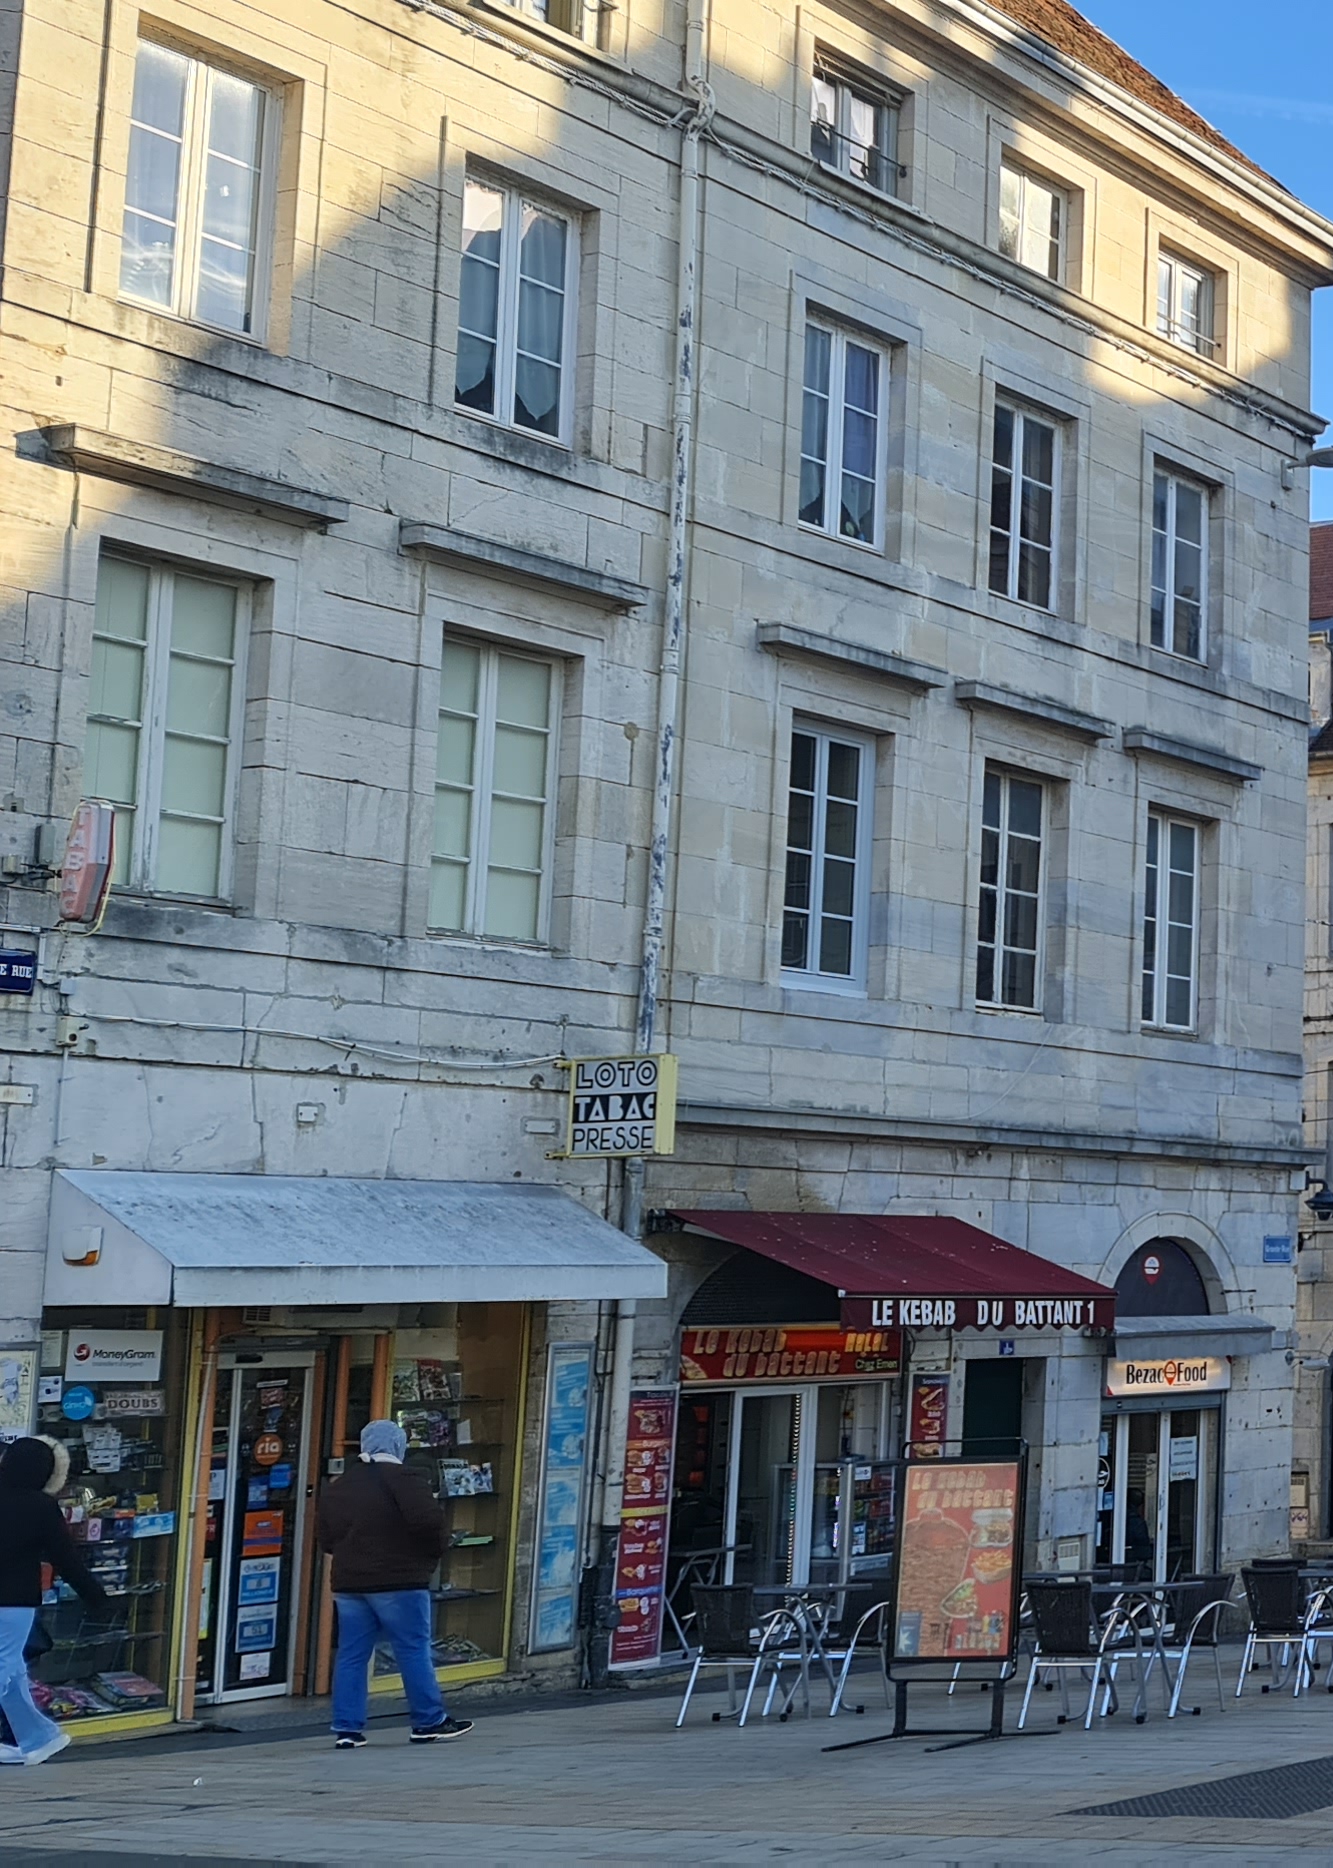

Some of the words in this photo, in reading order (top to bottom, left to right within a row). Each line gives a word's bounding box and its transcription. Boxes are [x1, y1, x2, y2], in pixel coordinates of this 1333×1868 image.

[60, 806, 92, 918] TABAC
[11, 964, 33, 979] RUE
[576, 1060, 658, 1089] LOTO
[574, 1093, 656, 1122] TABAC
[571, 1125, 655, 1152] PRESSE
[871, 1300, 893, 1326] LE
[900, 1300, 956, 1326] KEBAB
[977, 1300, 1004, 1325] DU
[1014, 1300, 1084, 1325] BATTANT
[1087, 1300, 1095, 1324] 1
[693, 1329, 720, 1354] Le
[91, 1349, 156, 1361] MoneyGram
[754, 1350, 841, 1377] battant
[1126, 1364, 1165, 1385] Bezac
[1177, 1361, 1208, 1382] Food
[107, 1398, 158, 1409] DOUBS
[257, 1437, 280, 1454] ria
